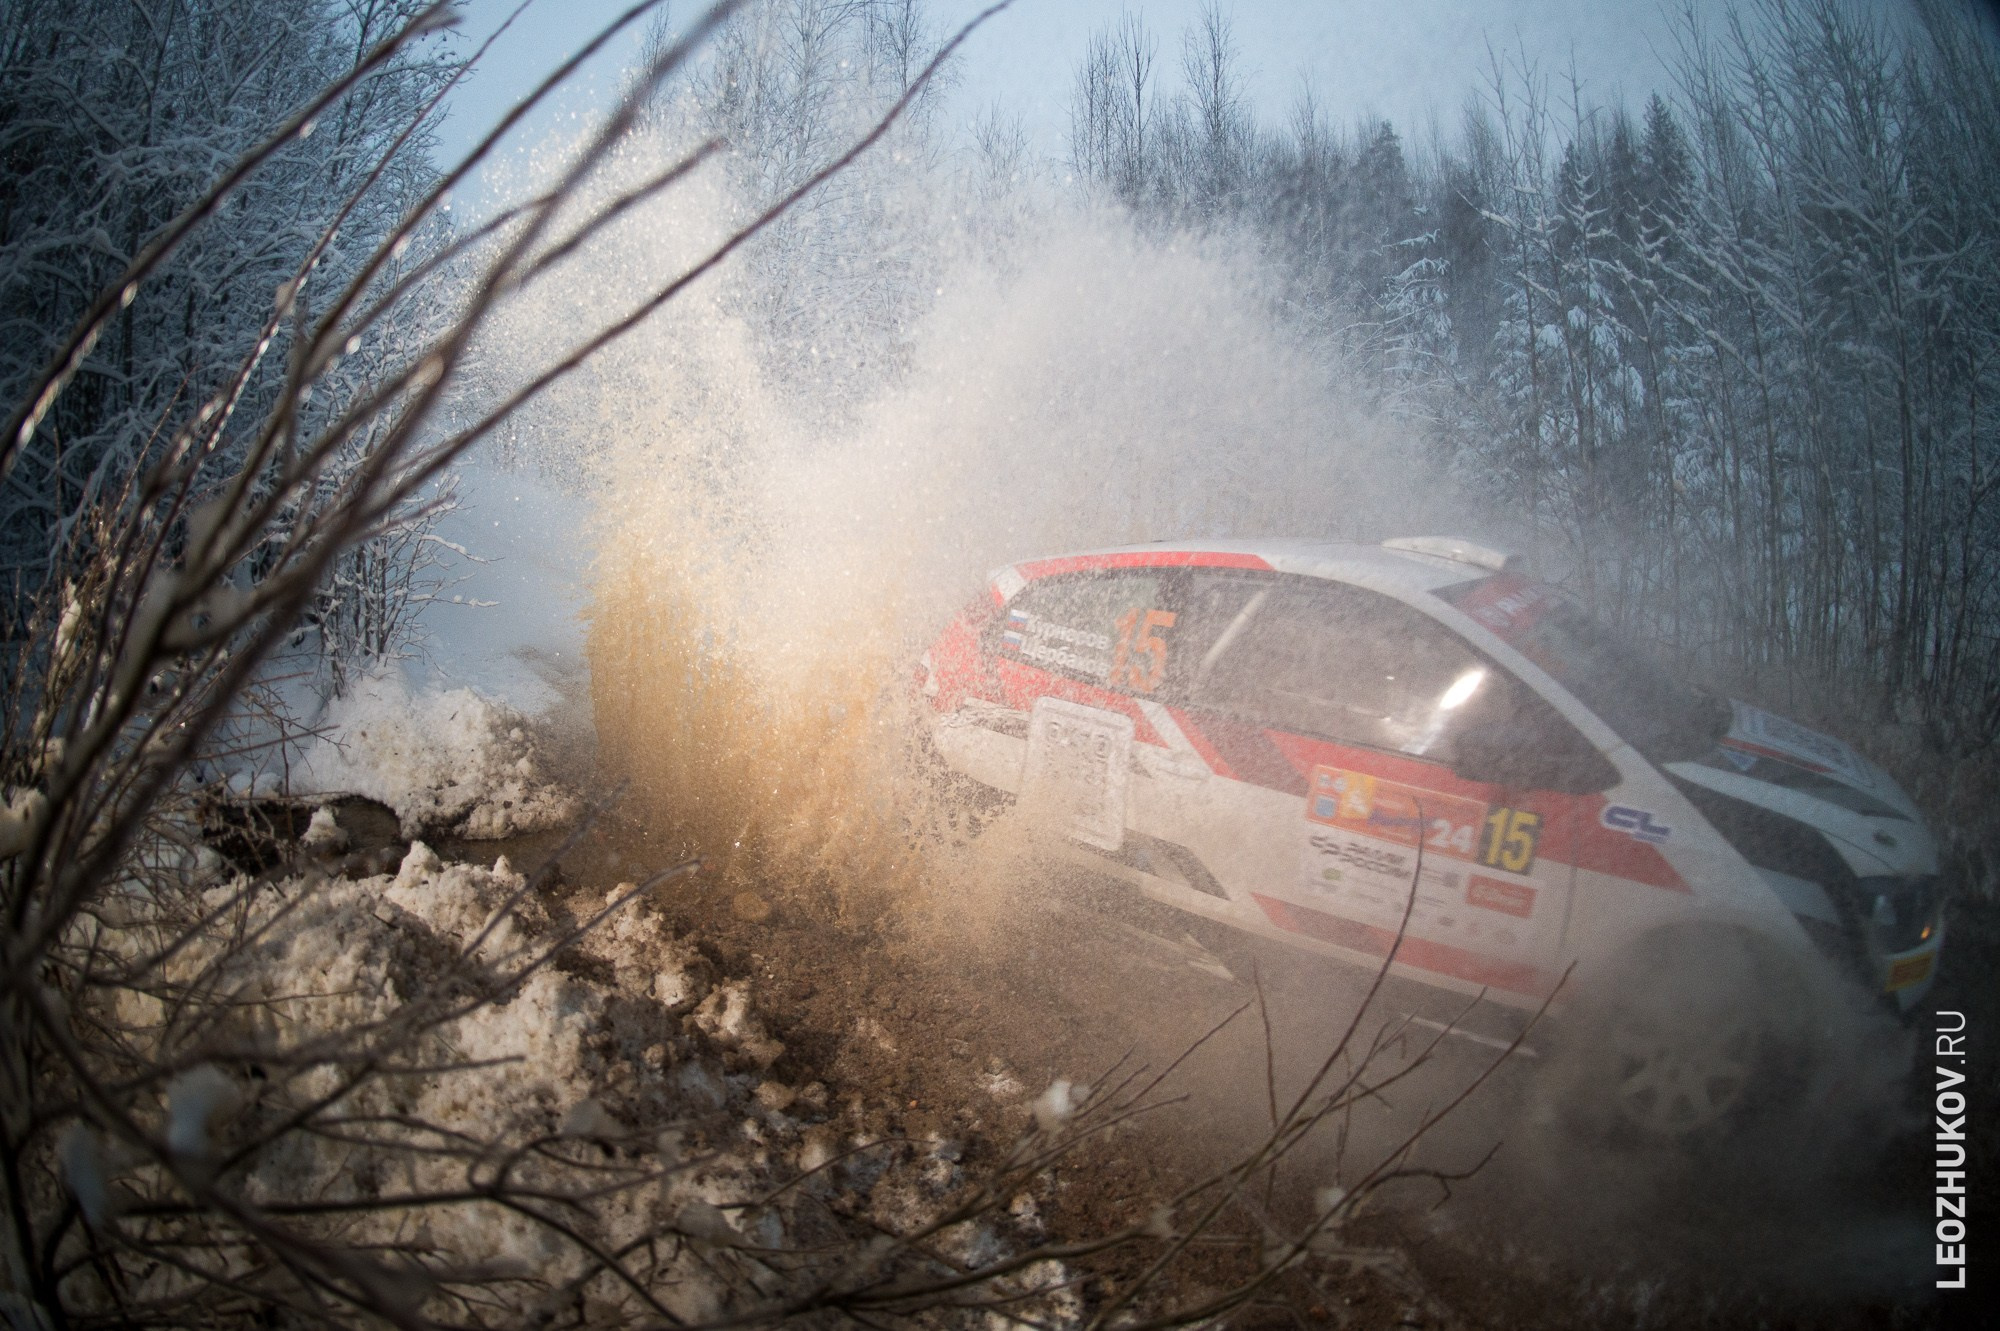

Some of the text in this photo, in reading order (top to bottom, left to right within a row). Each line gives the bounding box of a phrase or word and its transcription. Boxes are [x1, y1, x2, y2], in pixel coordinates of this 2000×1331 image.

[1110, 608, 1177, 692] 15
[1430, 819, 1474, 852] 24
[1486, 807, 1540, 871] 15
